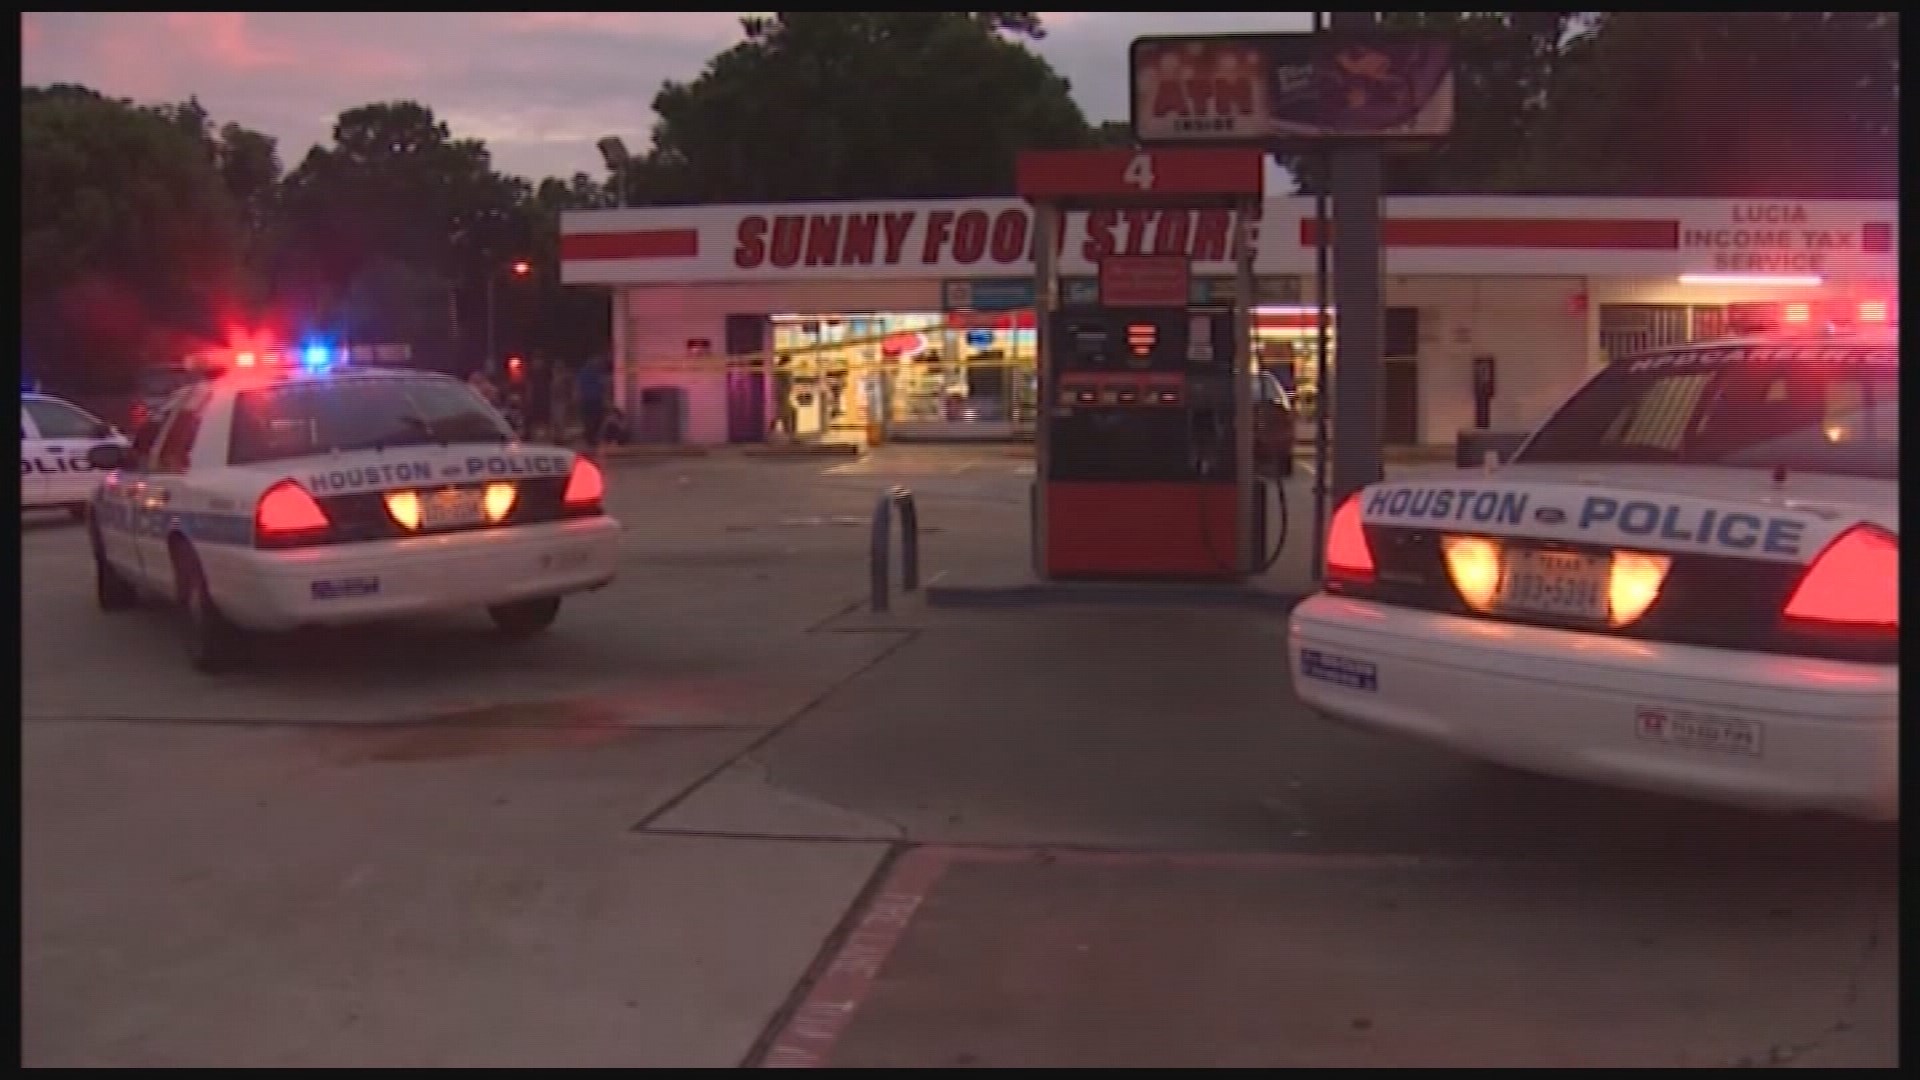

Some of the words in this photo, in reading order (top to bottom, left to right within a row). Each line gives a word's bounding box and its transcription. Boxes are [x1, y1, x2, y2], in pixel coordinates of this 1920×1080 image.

[1123, 155, 1154, 190] 4
[1732, 204, 1808, 223] LUCIA
[734, 212, 912, 269] SUNNY
[1684, 230, 1790, 249] INCOME
[1802, 230, 1853, 248] TAX
[1714, 254, 1825, 272] SERVICE
[309, 461, 431, 491] HOUSTON
[464, 455, 568, 476] POLICE
[1365, 487, 1529, 526] HOUSTON
[1577, 496, 1806, 556] POLICE
